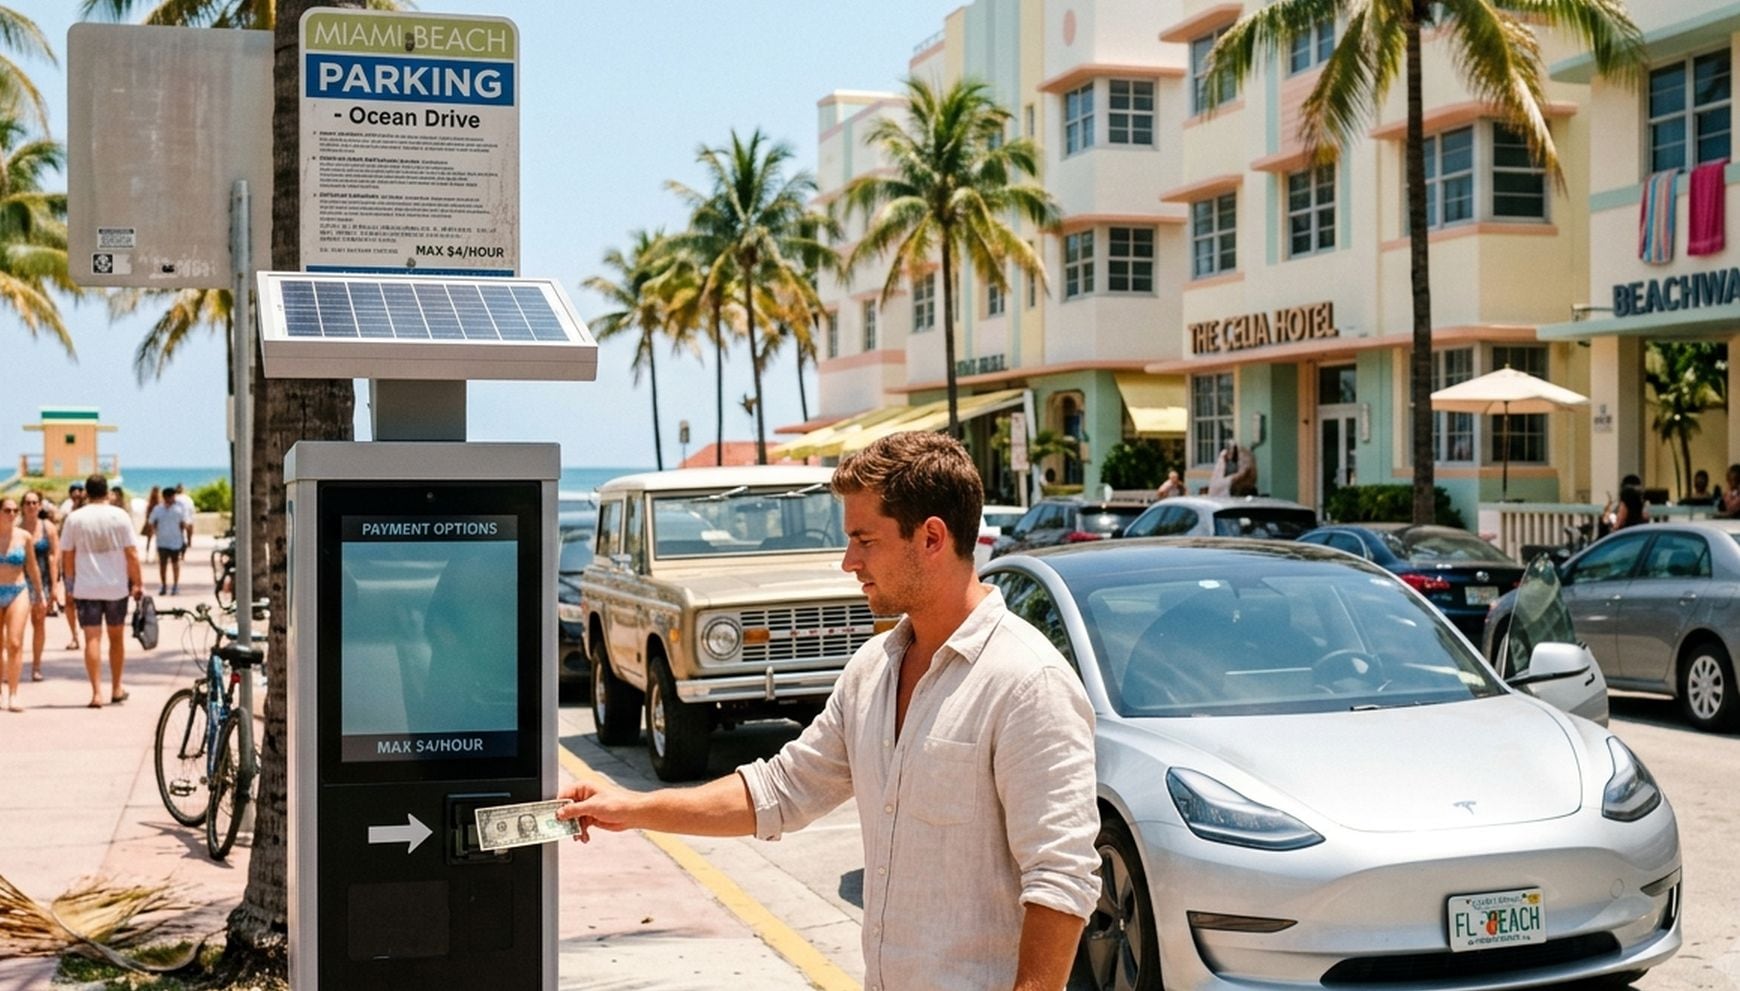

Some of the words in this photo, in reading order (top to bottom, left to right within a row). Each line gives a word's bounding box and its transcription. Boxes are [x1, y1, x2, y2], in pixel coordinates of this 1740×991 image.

[314, 21, 402, 48] MIAMI
[413, 25, 506, 53] BEACH
[319, 62, 503, 98] PARKING
[350, 106, 417, 127] Ocean
[425, 109, 481, 129] Drive
[415, 245, 444, 257] MAX
[1613, 267, 1740, 318] BEACHWA
[1187, 320, 1221, 355] THE
[1221, 312, 1272, 352] CELIA
[1273, 301, 1340, 343] HOTEL
[362, 522, 431, 536] PAYMENT
[433, 522, 498, 536] OPTIONS
[377, 740, 412, 754] MAX
[1455, 911, 1477, 938] FL
